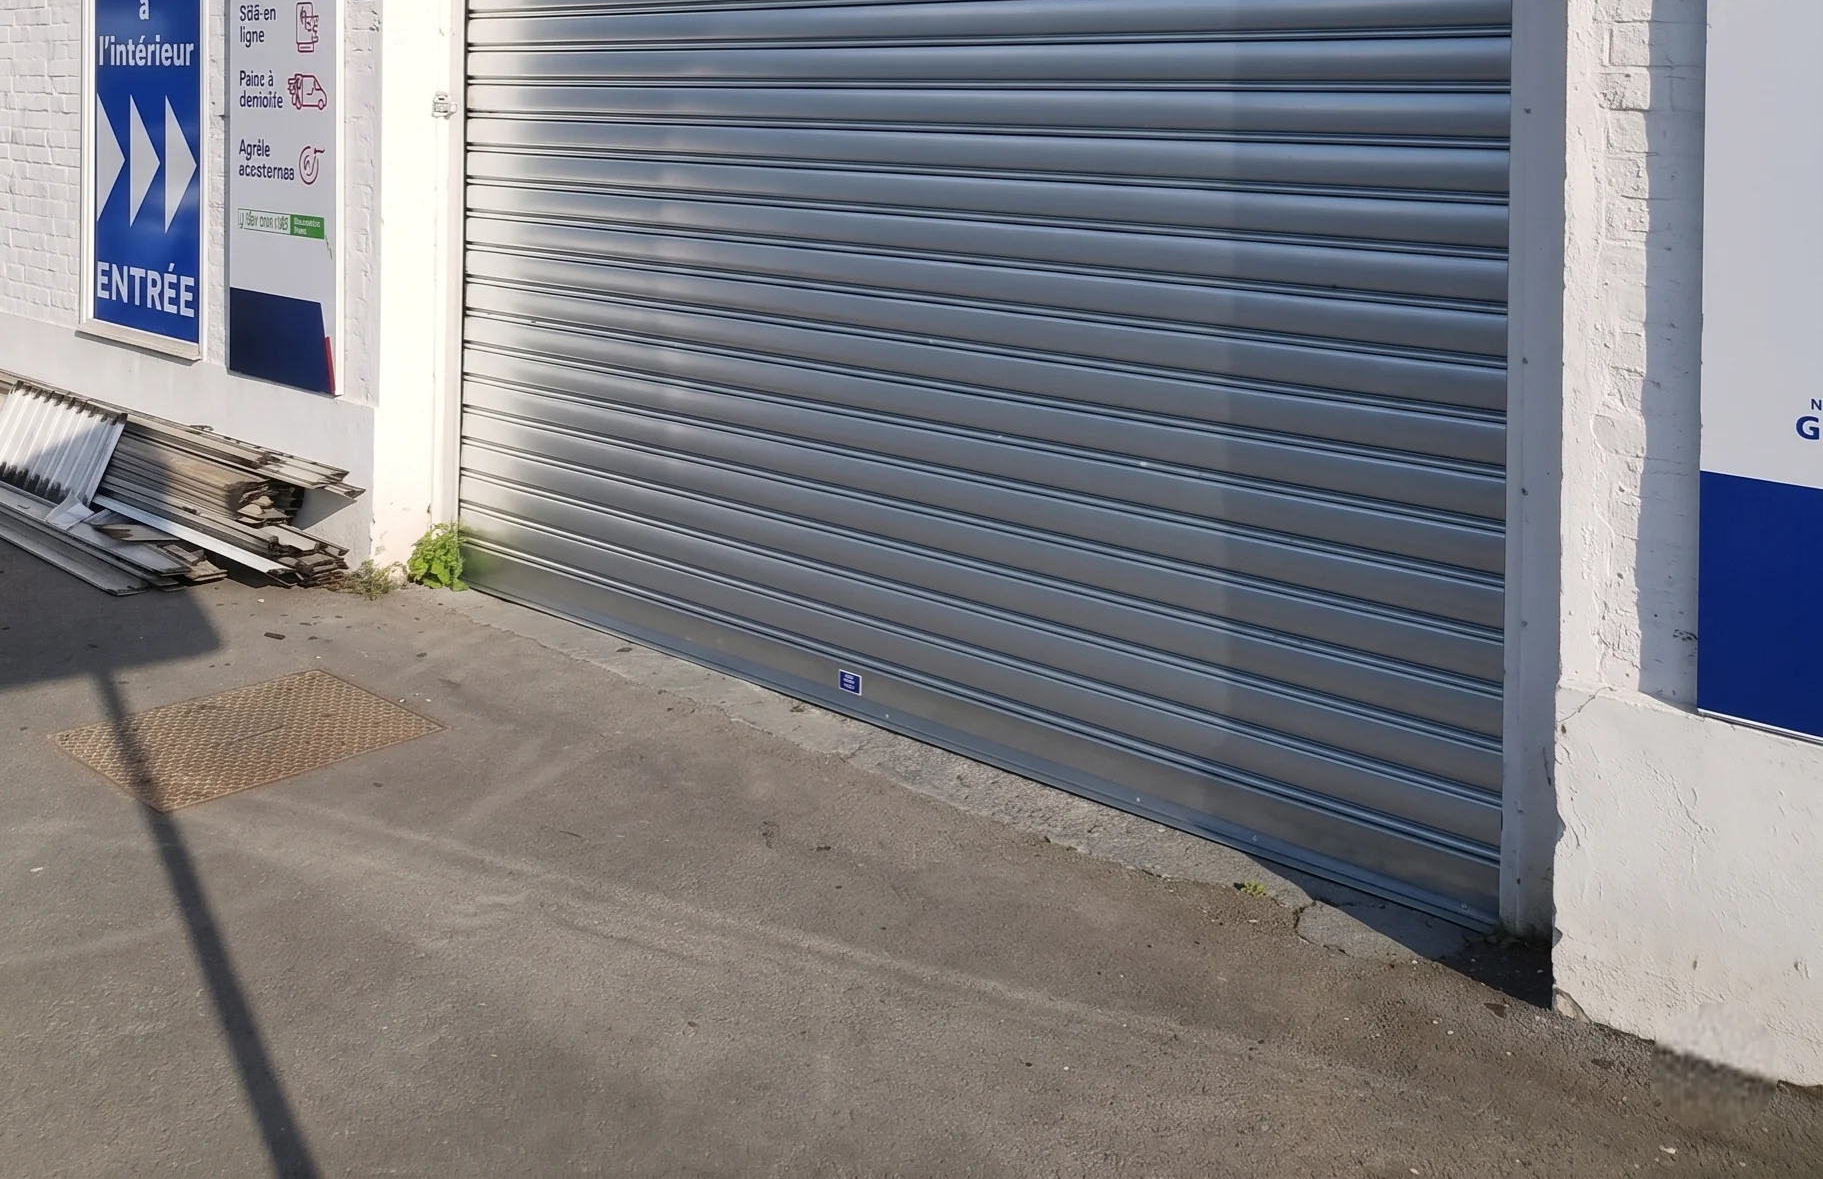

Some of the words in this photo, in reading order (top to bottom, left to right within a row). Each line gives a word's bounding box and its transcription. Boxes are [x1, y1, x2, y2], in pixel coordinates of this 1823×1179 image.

[99, 34, 195, 67] l'intérieur
[240, 25, 265, 49] ligne
[97, 260, 195, 318] ENTRÉE
